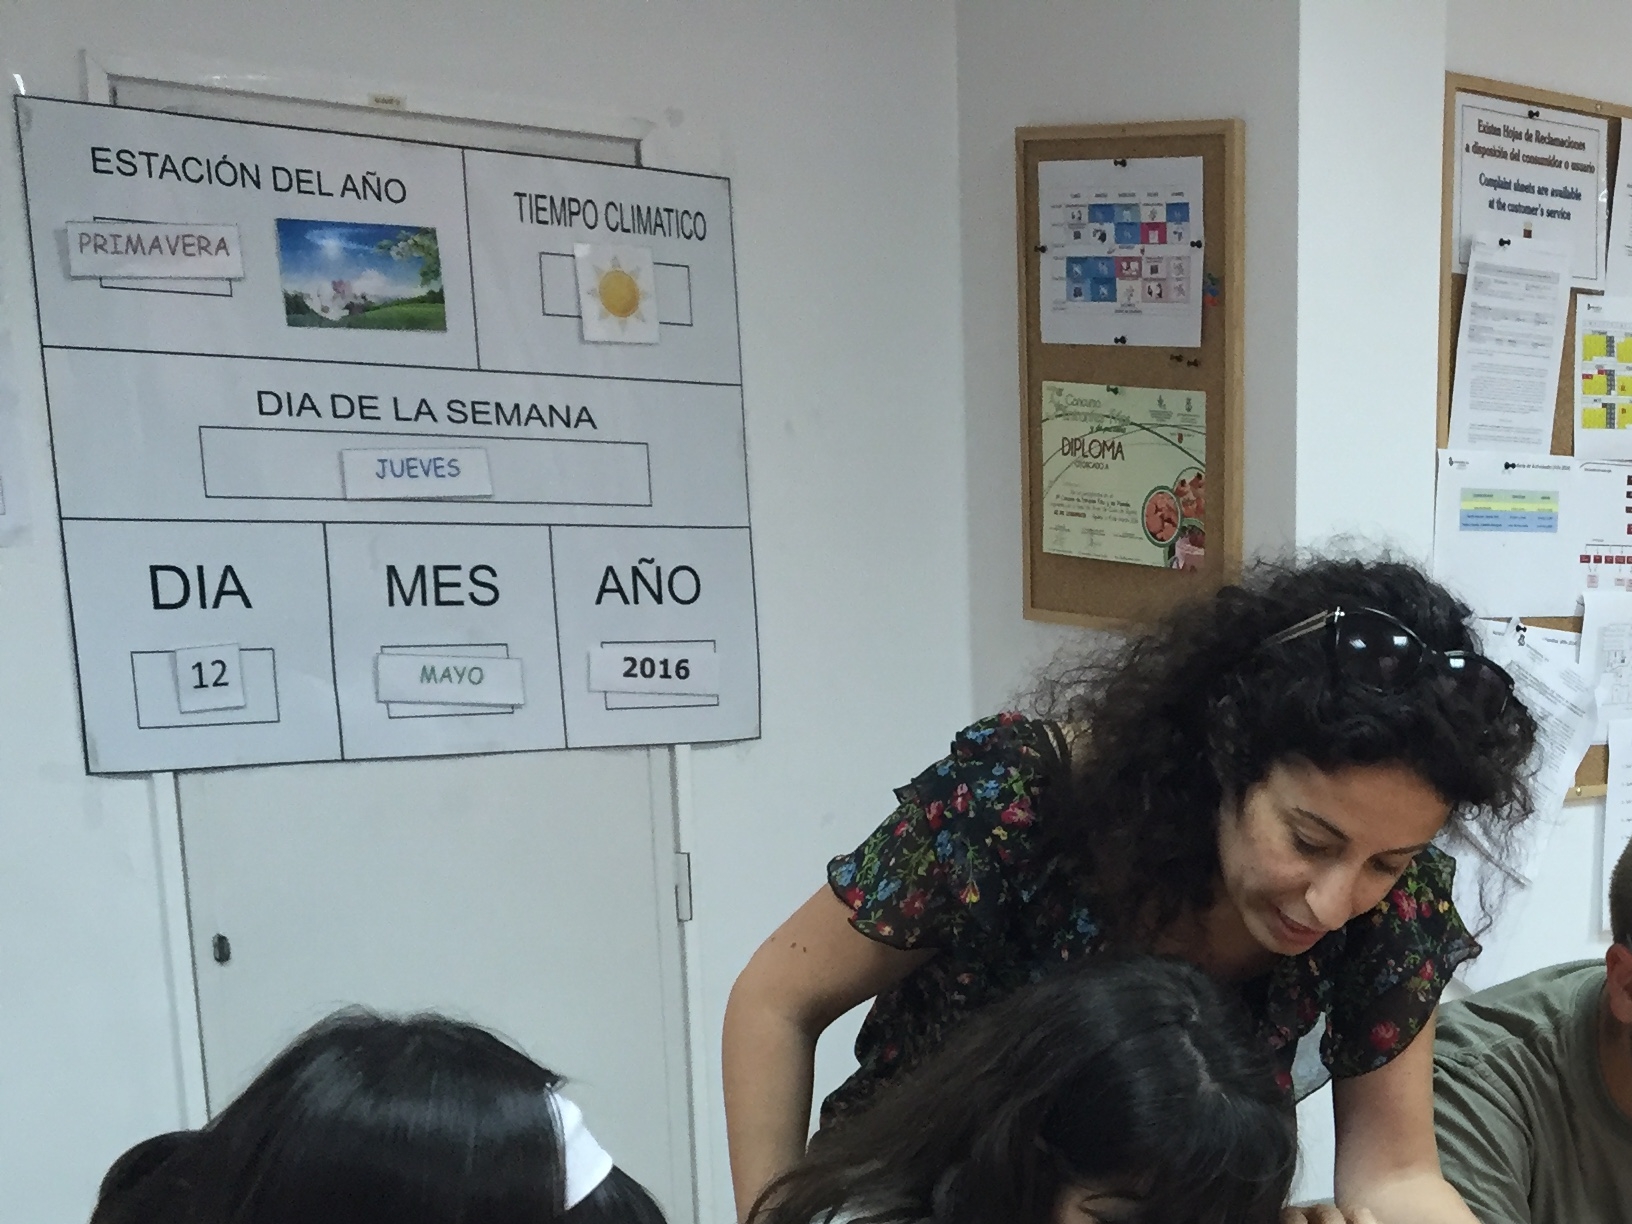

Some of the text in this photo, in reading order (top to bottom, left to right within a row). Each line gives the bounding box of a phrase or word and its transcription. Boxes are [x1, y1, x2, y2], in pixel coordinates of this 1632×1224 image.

[1478, 118, 1586, 151] Existen Hojas de Reclamaciones
[1465, 141, 1596, 174] a disposición del consumidor o usuario
[91, 146, 407, 204] ESTACIÓN DEL AÑO
[1479, 172, 1582, 201] Complaint sheets are available
[513, 191, 708, 242] TIEMPO CLIMATICO
[1488, 198, 1572, 221] at the customer's service
[77, 232, 231, 257] PRIMAVERA
[256, 390, 598, 430] DIA DE LA SEMANA
[1061, 436, 1125, 461] DIPLOMA
[375, 457, 461, 480] JUEVES
[149, 564, 253, 610] DIA
[386, 564, 501, 608] MES
[595, 557, 701, 605] AÑO
[191, 659, 230, 689] 12
[419, 665, 485, 686] MAYO
[622, 656, 691, 680] 2016
